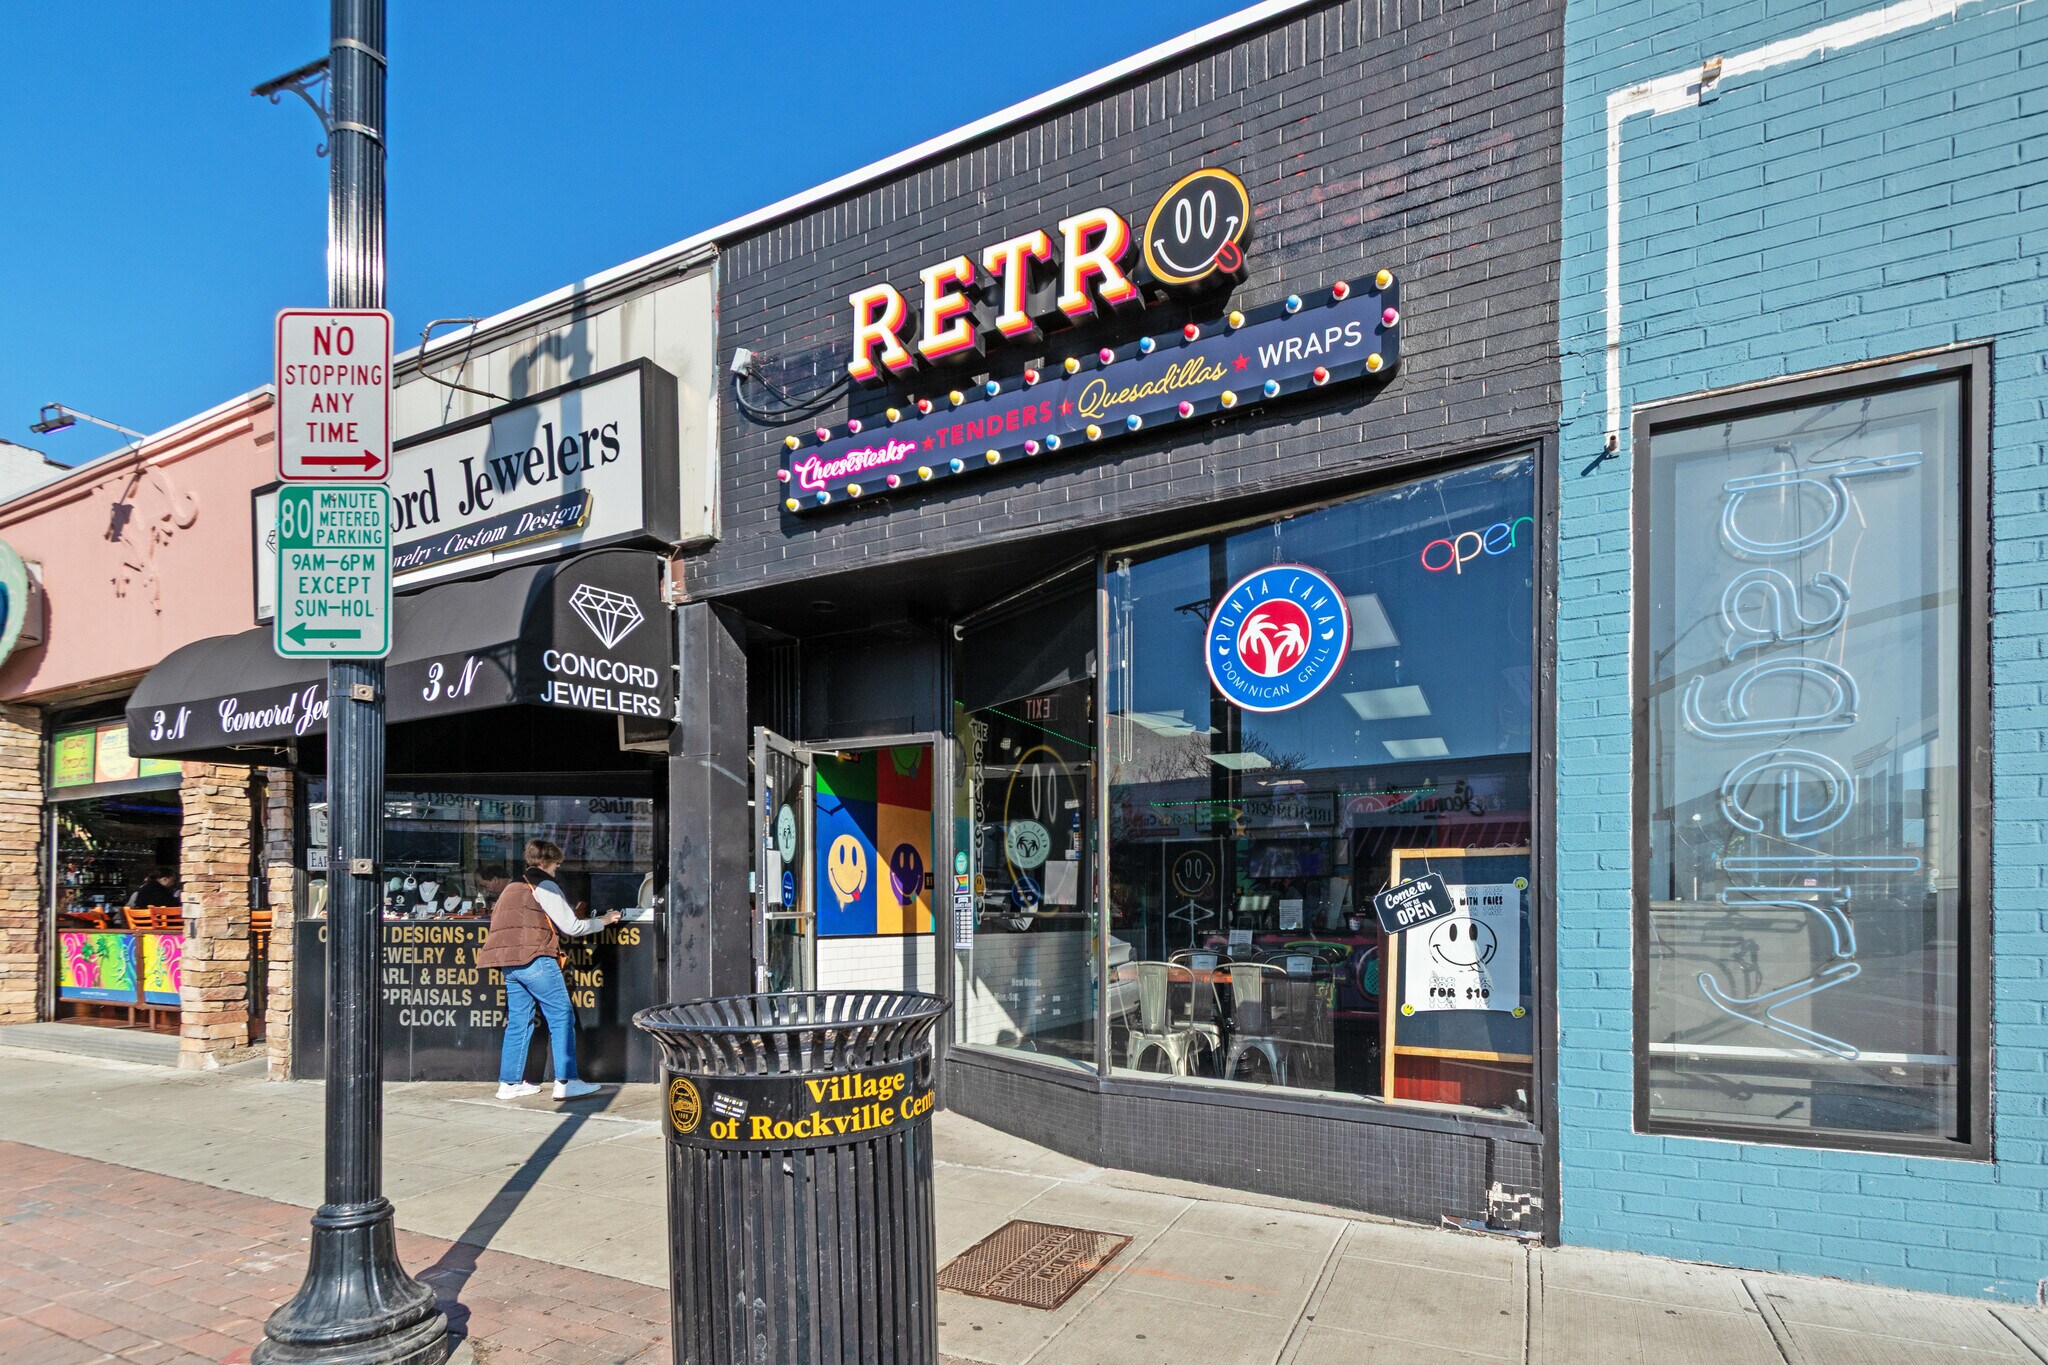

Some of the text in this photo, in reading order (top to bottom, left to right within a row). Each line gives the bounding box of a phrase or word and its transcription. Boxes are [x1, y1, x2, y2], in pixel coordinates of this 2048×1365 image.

[314, 326, 354, 355] NO
[285, 365, 382, 385] STOPPING
[311, 393, 354, 413] ANY
[794, 321, 1363, 489] Cheesesteaks TENDERS Quesadillas WRAPS
[306, 423, 358, 442] TIME
[458, 421, 620, 516] Jewelers
[320, 493, 377, 508] MINUTE
[281, 499, 312, 539] 80
[320, 512, 380, 526] METERED
[317, 529, 382, 544] PARKING
[393, 504, 582, 568] welry Custom Design
[1421, 516, 1534, 575] open
[299, 577, 371, 594] EXCEPT
[295, 600, 374, 617] SUN-HOL
[1216, 577, 1336, 641] PUNTA CANA
[543, 650, 659, 688] CONCORD
[1222, 647, 1329, 698] DOMINICAN GRILL
[150, 709, 166, 741] 3
[167, 706, 191, 740] N
[218, 693, 298, 733] Concord
[422, 662, 444, 701] 3
[447, 656, 483, 698] N
[540, 680, 661, 717] JEWELERS
[968, 718, 988, 741] THE
[1384, 881, 1432, 909] Come in
[1403, 898, 1420, 909] WE'RE
[1460, 897, 1478, 906] WITH
[1483, 896, 1503, 906] FRIES
[1396, 899, 1437, 925] OPEN
[391, 926, 465, 943] DESIGNS
[383, 947, 445, 964] WELRY
[455, 947, 465, 964] &
[420, 967, 431, 985] &
[436, 968, 479, 985] BEAD
[383, 989, 472, 1006] PPRAISALS
[1430, 987, 1490, 999] FOR $10
[400, 1010, 456, 1027] CLOCK
[805, 1072, 906, 1103] Village
[750, 1104, 894, 1140] Rockville
[983, 1231, 1072, 1292] TRAFFIC SIGNALS
